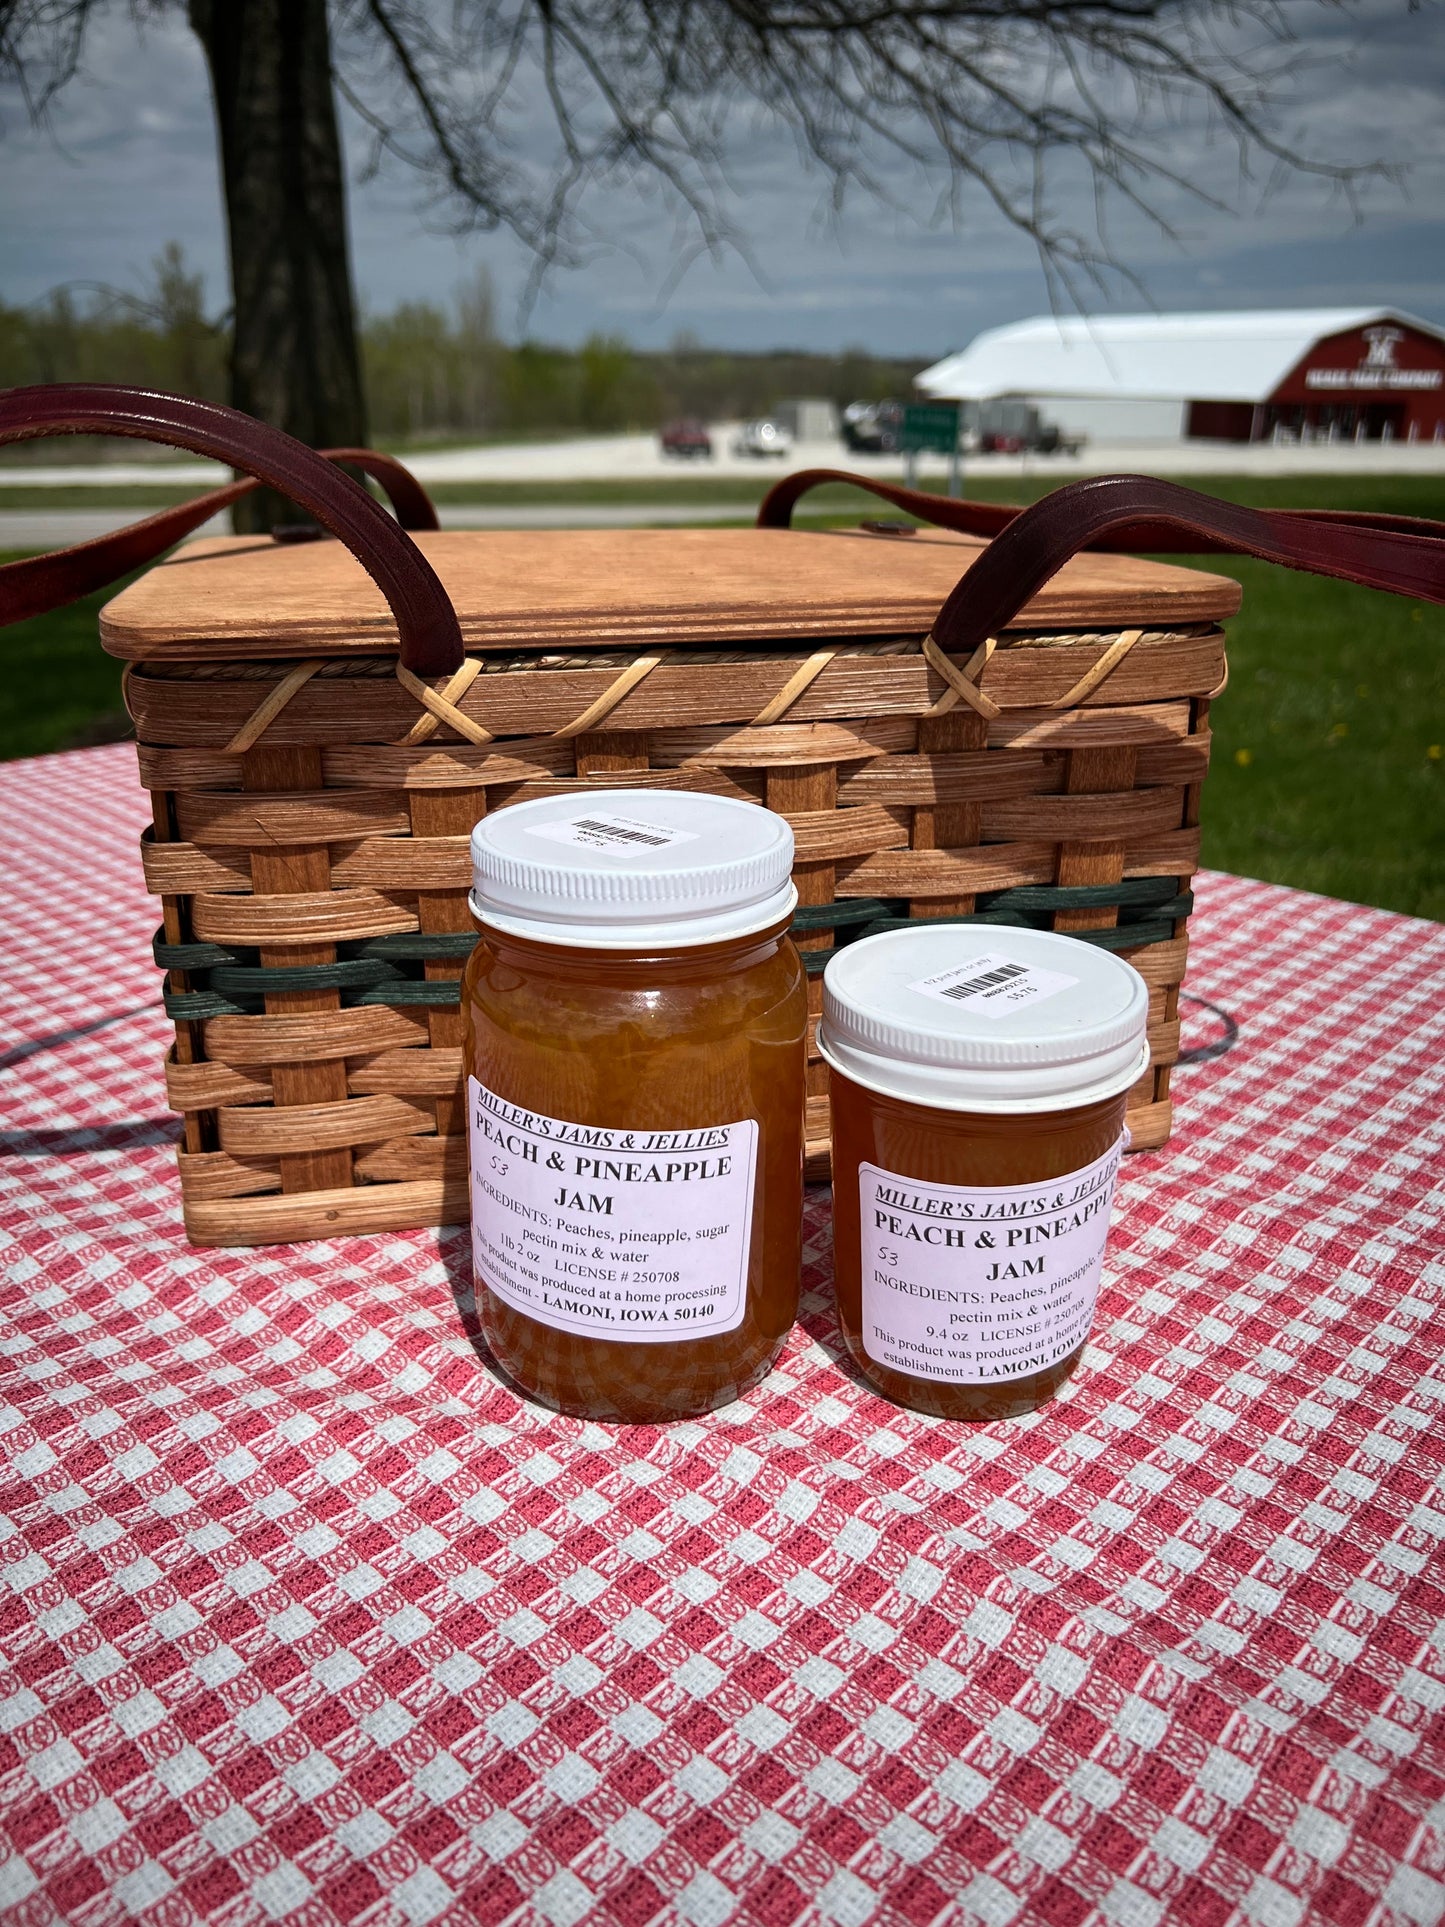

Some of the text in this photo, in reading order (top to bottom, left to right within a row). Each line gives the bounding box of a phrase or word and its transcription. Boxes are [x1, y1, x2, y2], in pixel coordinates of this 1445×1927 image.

[478, 1086, 731, 1150] MILLER'S JAMS & JELLIES
[475, 1109, 732, 1183] PEACH & PINEAPPLE
[475, 1170, 730, 1245] INGREDIENTS: Peaches, pineapple, sugar
[554, 1187, 615, 1216] JAM
[875, 1184, 976, 1218] MILLER'S
[979, 1196, 1047, 1219] JAM'S
[1050, 1192, 1065, 1209] &
[522, 1228, 650, 1263] pectin mix & water
[873, 1208, 966, 1248] PEACH
[974, 1230, 997, 1249] &
[488, 1243, 518, 1271] product
[519, 1265, 539, 1282] was
[541, 1275, 596, 1298] produced
[599, 1289, 611, 1300] at
[614, 1292, 622, 1301] a
[625, 1290, 661, 1303] home
[664, 1285, 728, 1304] processing
[517, 1242, 524, 1256] 2
[526, 1250, 540, 1263] oz
[554, 1259, 617, 1282] LICENSE
[620, 1271, 629, 1282] #
[632, 1270, 680, 1284] 250708
[985, 1255, 1046, 1282] JAM
[481, 1252, 532, 1297] establishment
[542, 1292, 616, 1323] LAMONI,
[620, 1308, 669, 1322] IOWA
[673, 1303, 715, 1322] 50140
[873, 1269, 985, 1304] INGREDIENTS:
[989, 1286, 1047, 1304] Peaches,
[949, 1290, 1073, 1325] pectin mix & water
[872, 1325, 896, 1345] This
[898, 1338, 944, 1357] product
[947, 1349, 972, 1360] was
[975, 1342, 1033, 1361] produced
[1034, 1340, 1046, 1350] at
[1047, 1336, 1054, 1345] a
[1055, 1319, 1079, 1341] home
[926, 1325, 947, 1340] 9.4
[951, 1331, 969, 1342] oz
[980, 1322, 1042, 1342] LICENSE
[1044, 1320, 1052, 1330] #
[1053, 1296, 1085, 1326] 250708
[883, 1351, 964, 1377] establishment
[978, 1354, 1050, 1378] LAMONI,
[1051, 1330, 1082, 1359] IOWA
